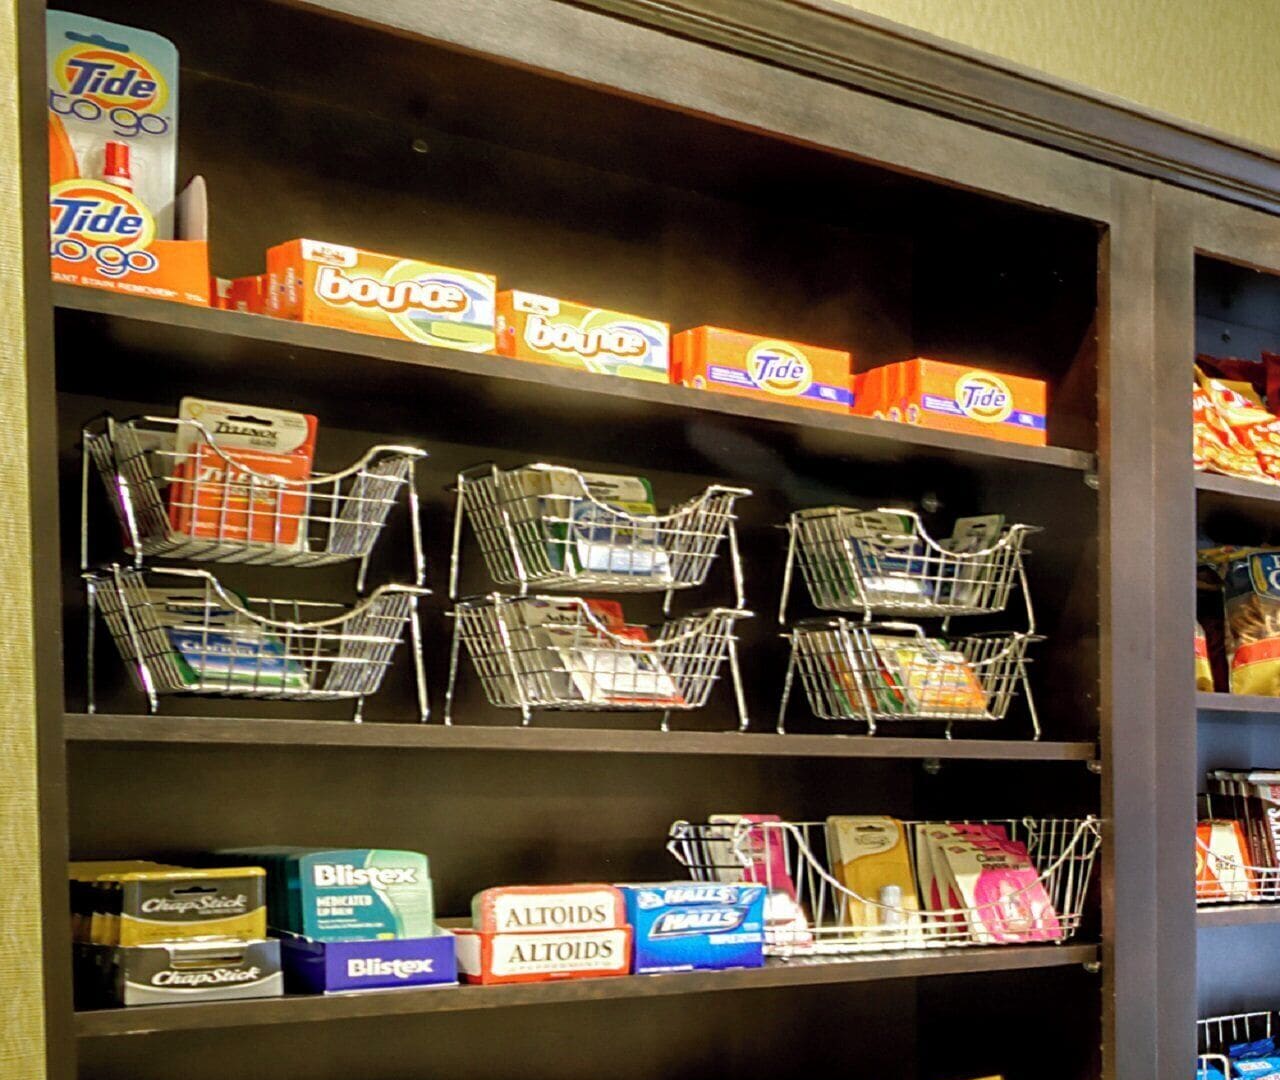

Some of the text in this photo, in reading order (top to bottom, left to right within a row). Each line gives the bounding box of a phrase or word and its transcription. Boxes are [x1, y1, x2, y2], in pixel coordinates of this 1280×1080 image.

[67, 58, 157, 98] Tide
[48, 87, 168, 137] to go
[51, 198, 143, 235] Tide
[51, 239, 157, 276] o go
[317, 265, 468, 313] bounce
[526, 313, 647, 358] bounce
[756, 354, 804, 382] Tide
[963, 384, 1006, 408] Tide
[215, 421, 278, 440] TYLENOL
[313, 863, 417, 890] Blistex
[141, 894, 248, 914] ChapStick
[664, 886, 730, 905] HALLS
[505, 904, 607, 929] ALTOIDS
[660, 909, 741, 932] HALLS
[508, 939, 614, 963] ALTOIDS
[151, 966, 262, 987] ChapStick
[347, 957, 435, 979] Blistex
